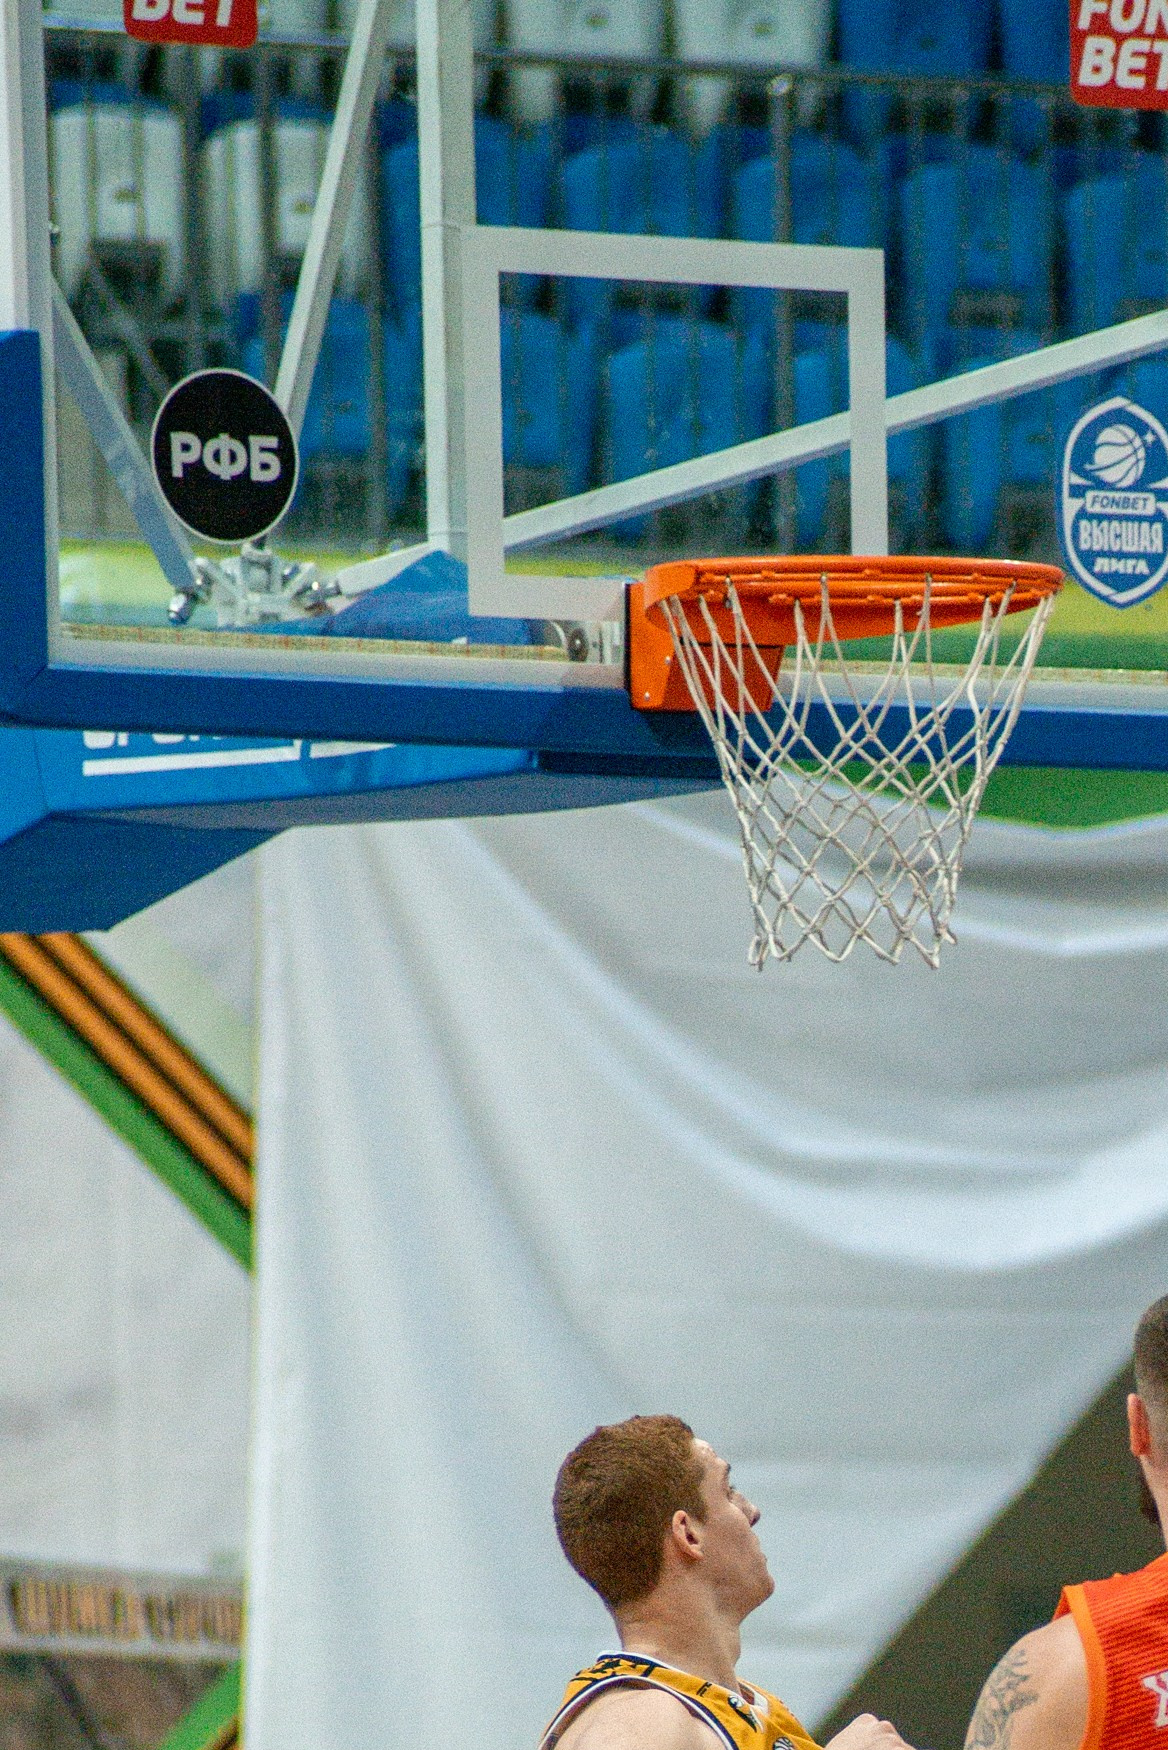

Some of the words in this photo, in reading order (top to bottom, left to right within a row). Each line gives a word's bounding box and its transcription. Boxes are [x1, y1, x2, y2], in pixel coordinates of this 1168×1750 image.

[169, 430, 282, 482] РФБ
[1090, 494, 1150, 511] FONBET
[1078, 519, 1164, 554] ВЫСШАЯ
[1093, 557, 1151, 575] ЛИГА
